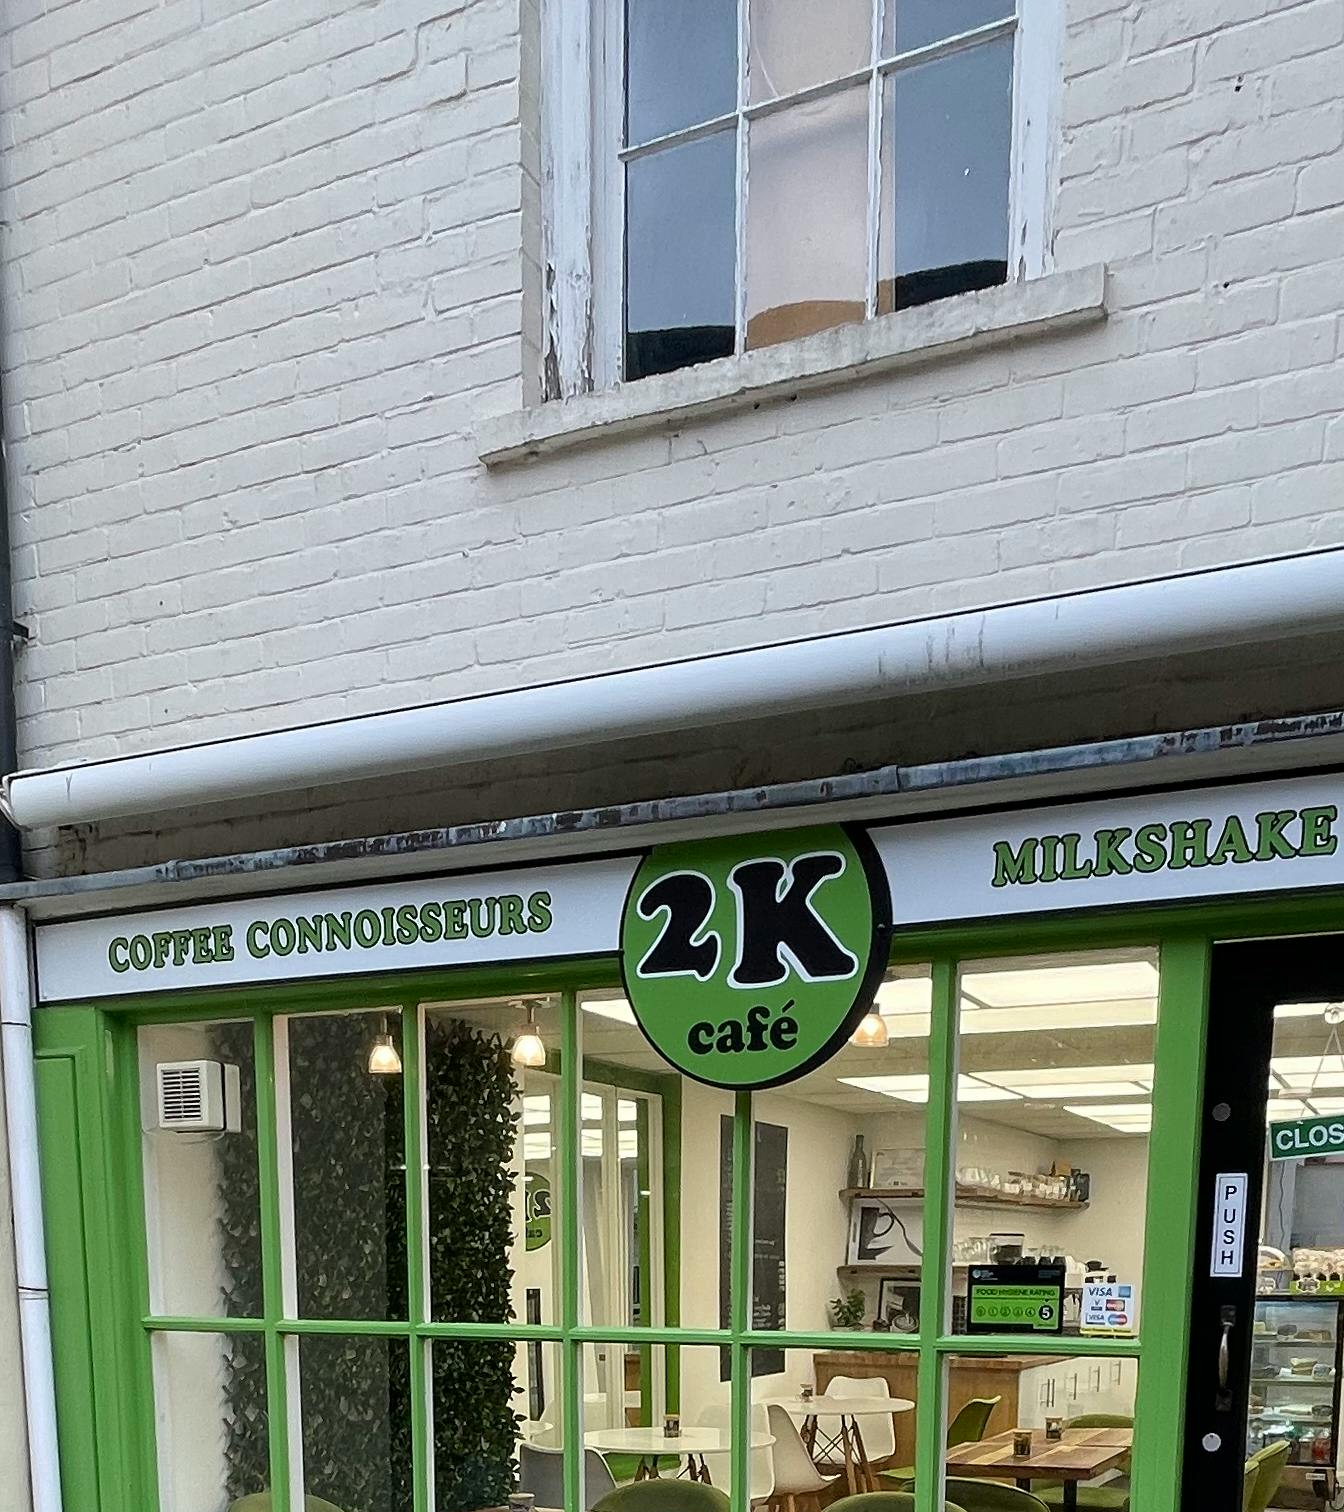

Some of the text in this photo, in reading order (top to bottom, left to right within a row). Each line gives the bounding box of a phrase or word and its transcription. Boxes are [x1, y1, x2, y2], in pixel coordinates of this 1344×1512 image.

[992, 805, 1338, 888] MILKSHAKE
[109, 891, 553, 973] COFFEE CONNOISSEURS
[636, 851, 859, 989] 2K
[687, 999, 799, 1056] café
[1220, 1185, 1238, 1265] PUSH
[976, 1288, 997, 1296] FOOD
[1029, 1288, 1056, 1297] RATING
[1088, 1286, 1113, 1297] VISA
